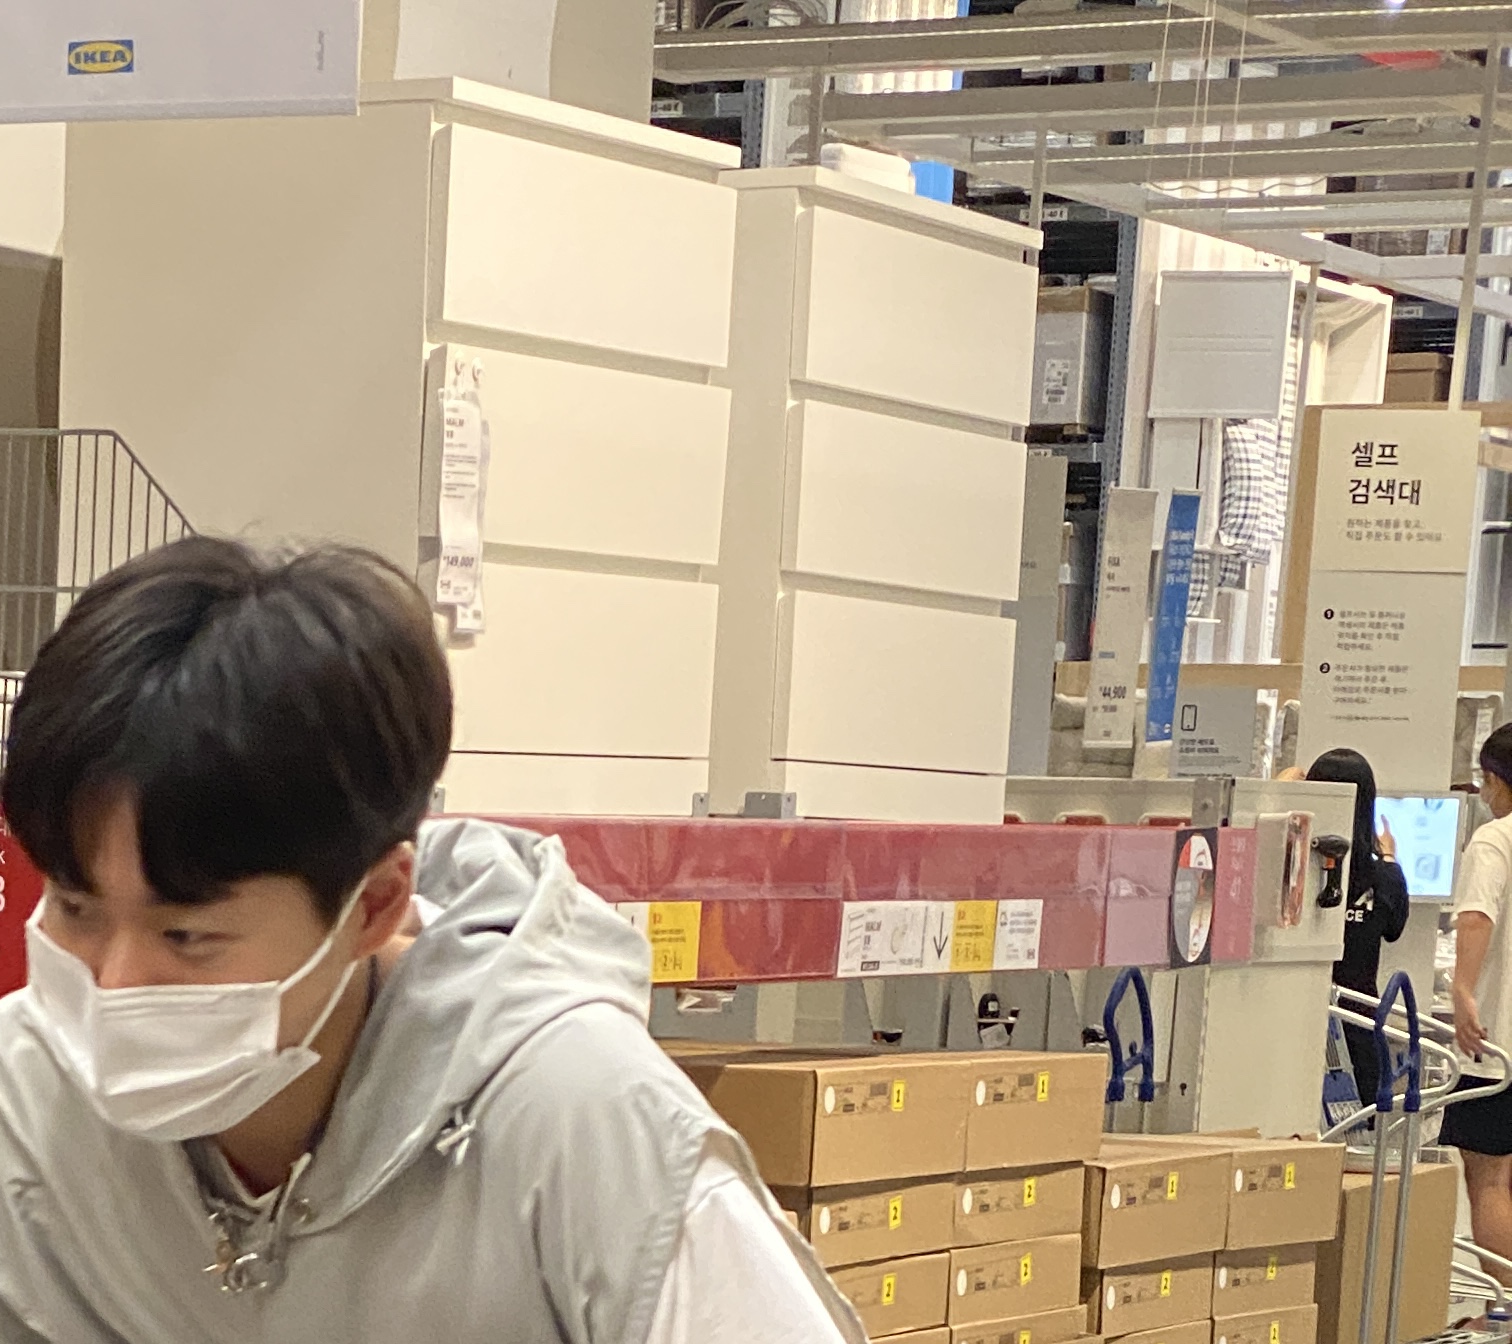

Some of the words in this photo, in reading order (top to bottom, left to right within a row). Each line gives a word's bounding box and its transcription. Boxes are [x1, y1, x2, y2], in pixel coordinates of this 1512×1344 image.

[73, 49, 127, 66] IKEA
[1351, 441, 1398, 468] 셀프
[1348, 478, 1421, 506] 검색대
